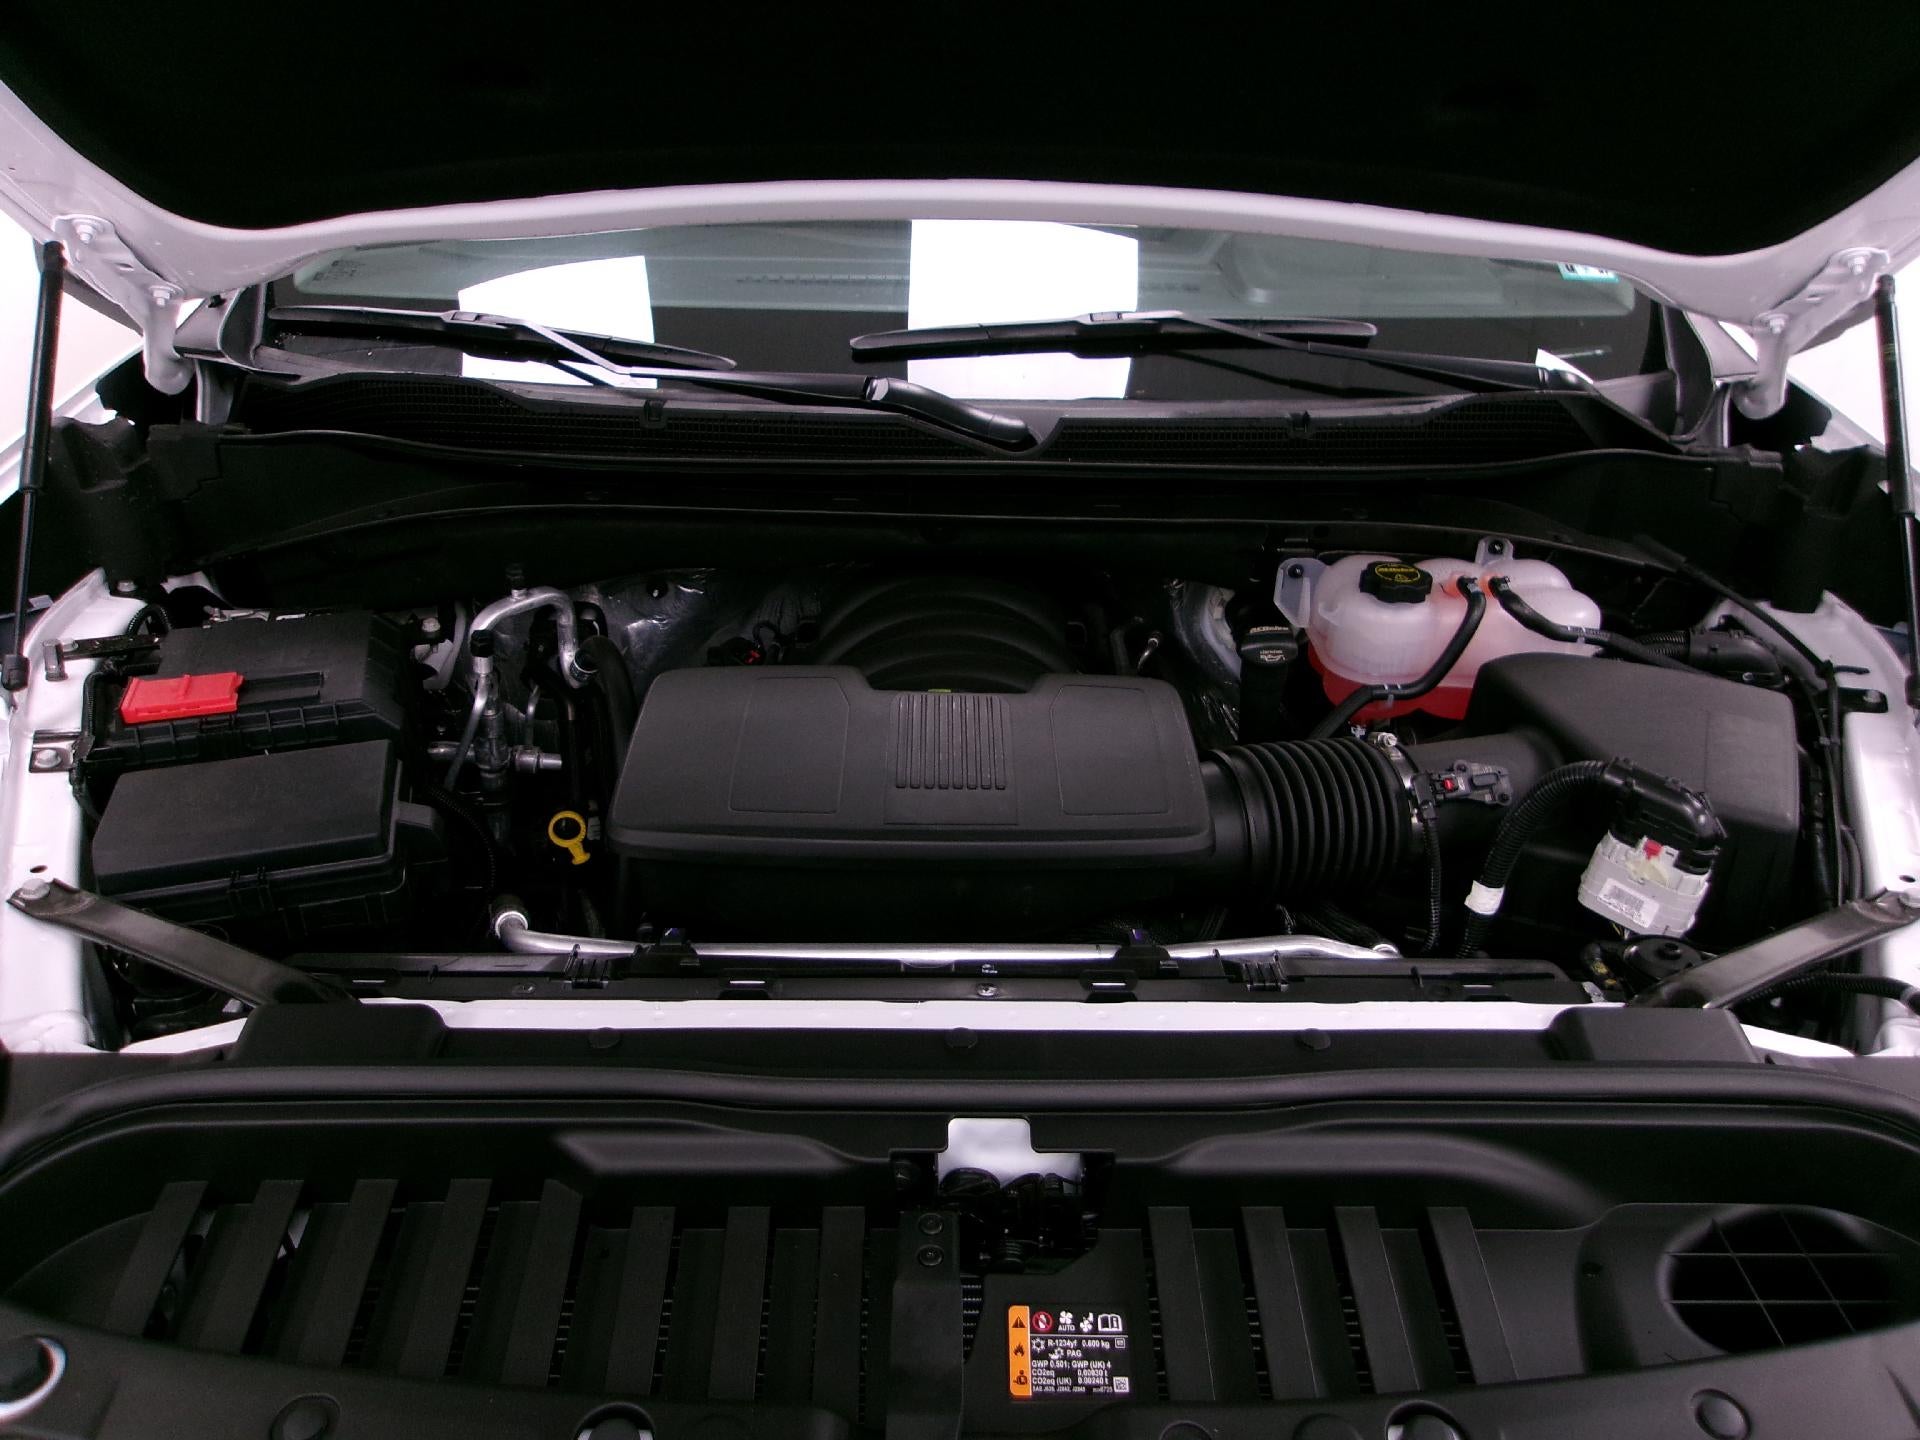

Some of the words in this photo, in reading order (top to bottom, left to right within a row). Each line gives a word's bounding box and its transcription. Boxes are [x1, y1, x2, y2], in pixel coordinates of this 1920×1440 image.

[1047, 1339, 1077, 1348] R-1234yf
[1101, 1340, 1110, 1349] kg
[1066, 1349, 1082, 1357] PAG
[1031, 1360, 1048, 1368] GWP
[1071, 1360, 1089, 1368] GWP
[1089, 1360, 1105, 1370] (UK)
